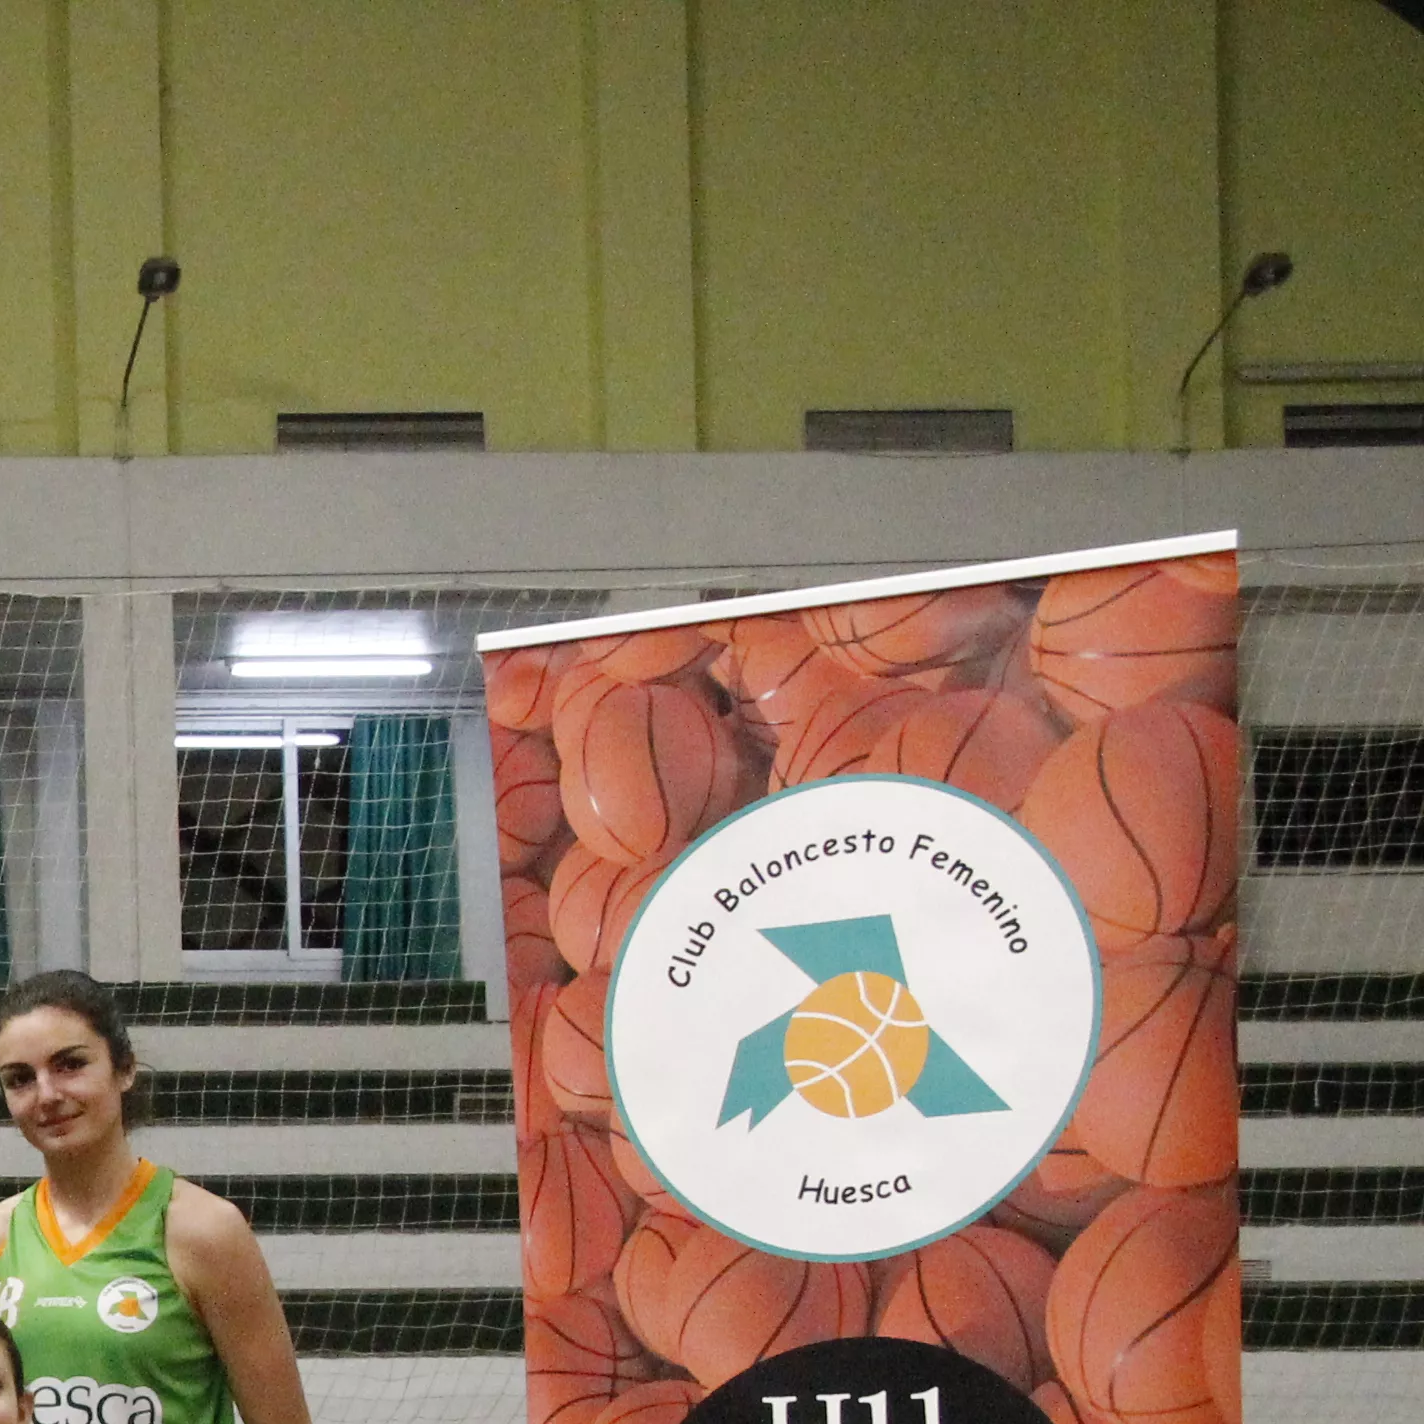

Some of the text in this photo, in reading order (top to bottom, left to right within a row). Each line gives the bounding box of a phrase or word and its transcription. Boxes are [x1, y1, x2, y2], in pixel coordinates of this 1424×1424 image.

[668, 829, 1027, 988] Club Baloncesto Femenino
[798, 1173, 912, 1205] Huesca
